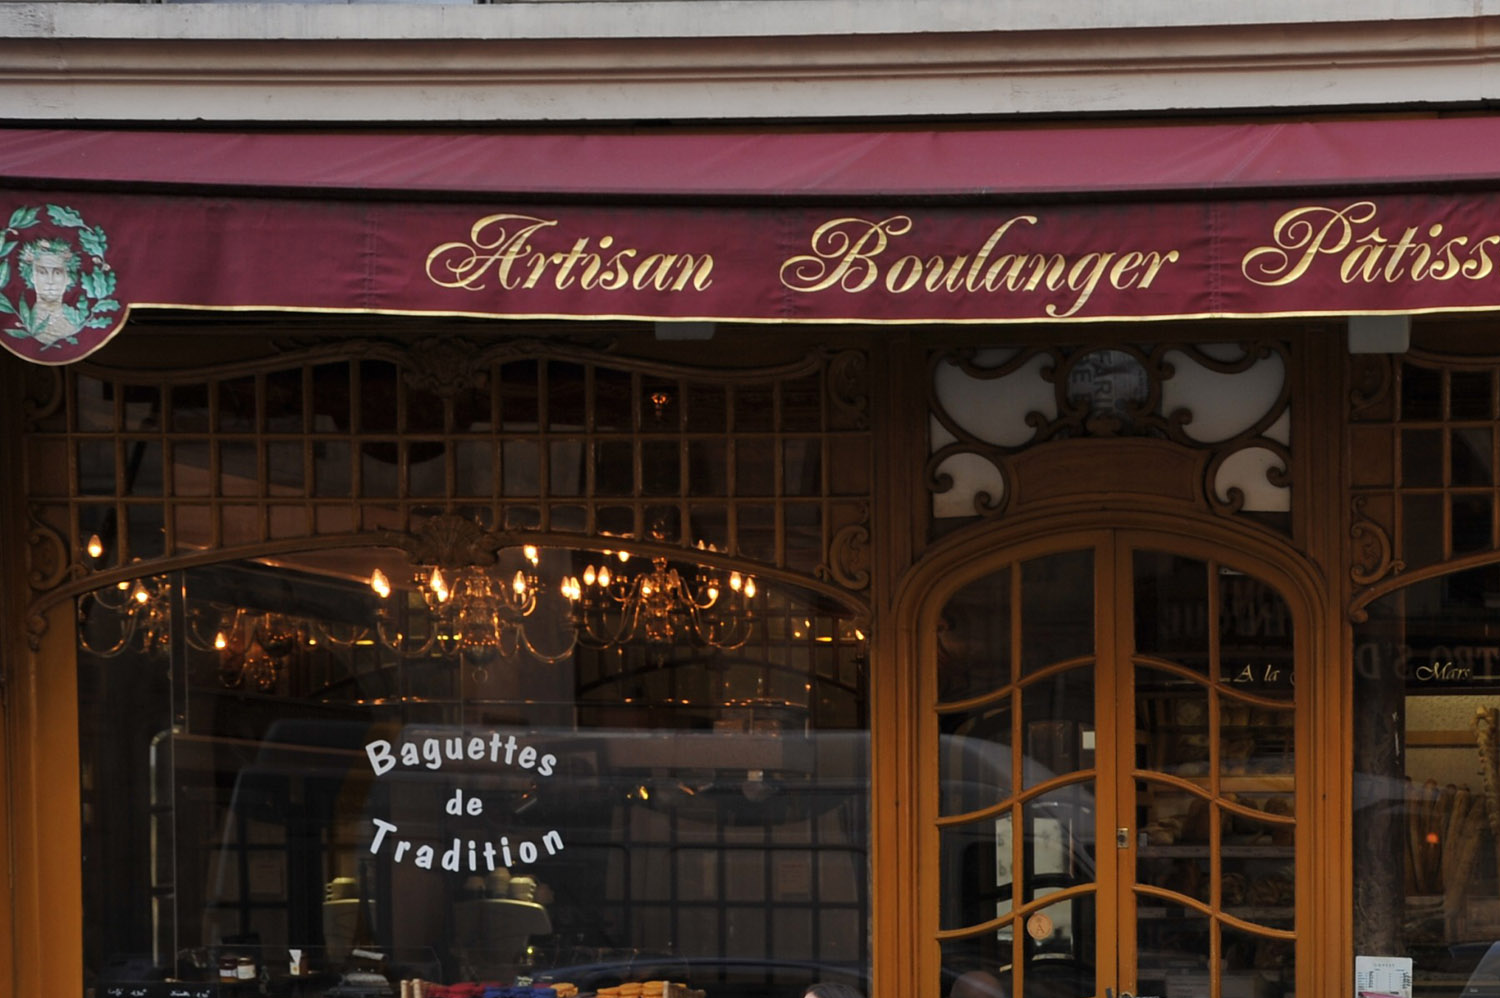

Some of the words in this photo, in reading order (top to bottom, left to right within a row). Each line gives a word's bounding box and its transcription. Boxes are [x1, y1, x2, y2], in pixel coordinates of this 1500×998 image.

[425, 214, 714, 292] Artisan
[779, 214, 1180, 318] Boulanger
[1233, 663, 1254, 682] A
[1263, 663, 1280, 682] la
[365, 732, 557, 777] Baguettes
[445, 788, 483, 816] de
[369, 818, 565, 873] Tradition
